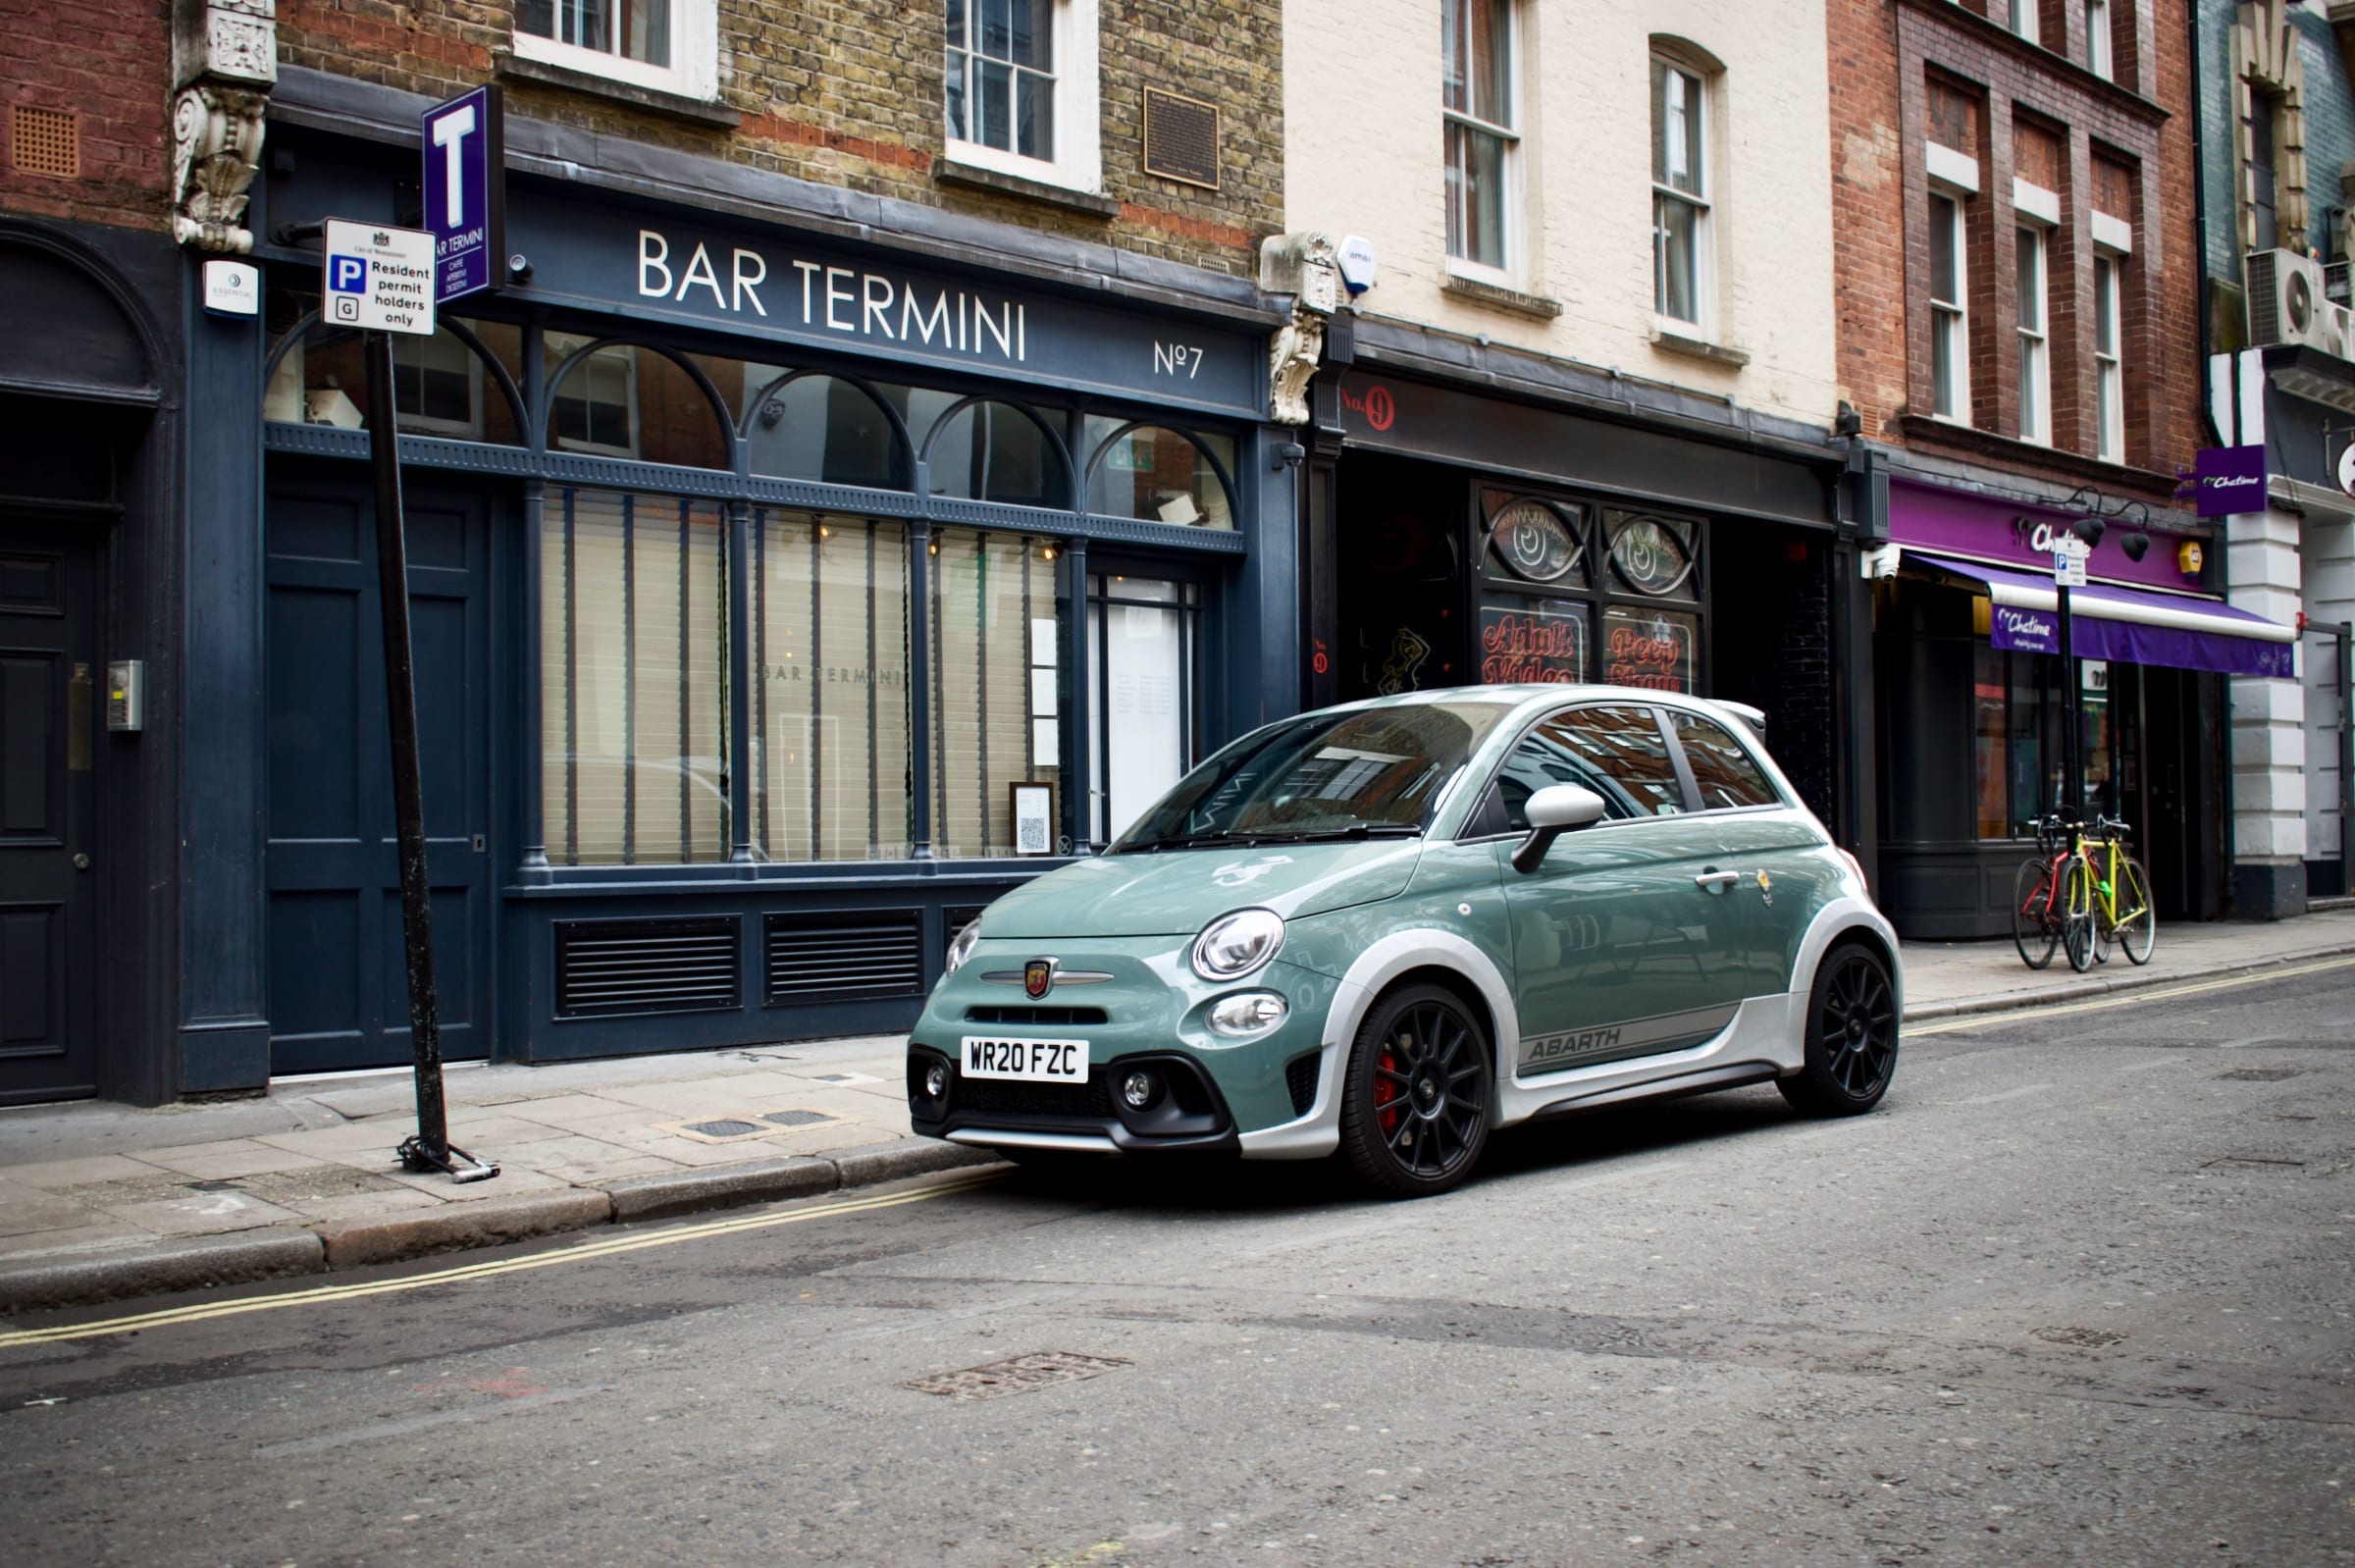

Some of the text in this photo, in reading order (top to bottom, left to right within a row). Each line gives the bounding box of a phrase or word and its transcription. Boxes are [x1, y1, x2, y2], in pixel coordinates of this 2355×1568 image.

[433, 105, 476, 229] T
[448, 228, 483, 252] TERMINI
[339, 259, 362, 289] P
[372, 261, 430, 280] Resident
[379, 281, 422, 294] permit
[639, 230, 1024, 361] BAR TERMINI
[342, 303, 352, 315] G
[375, 294, 425, 311] holders
[386, 313, 414, 327] only
[2213, 475, 2260, 489] Chatime
[2059, 554, 2066, 569] P
[1482, 614, 1574, 658] Adult
[2008, 612, 2051, 637] Chatime
[1610, 628, 1679, 674] Peep
[762, 664, 904, 686] BAR TERMINI
[1529, 1027, 1622, 1060] ABARTH
[970, 1041, 1077, 1075] WR20 FZC
